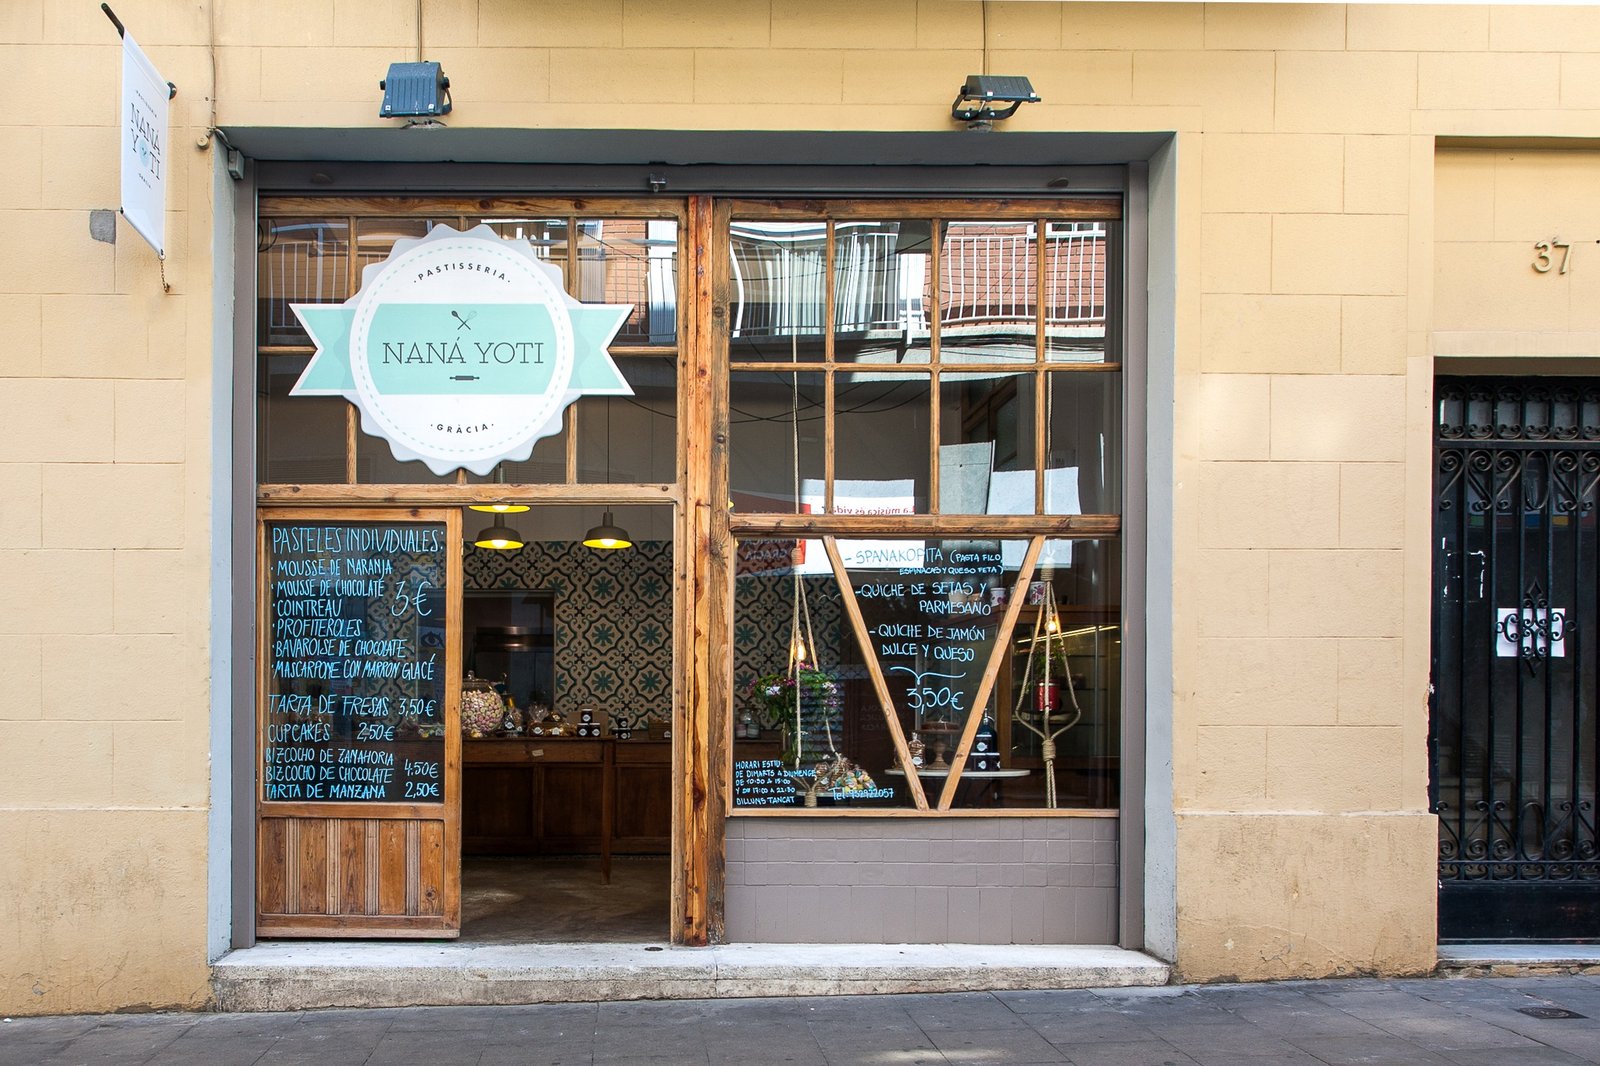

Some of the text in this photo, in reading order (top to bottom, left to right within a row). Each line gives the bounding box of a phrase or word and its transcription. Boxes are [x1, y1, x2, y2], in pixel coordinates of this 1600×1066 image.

[1532, 237, 1571, 275] 37
[382, 337, 544, 364] NANÁ YOTI
[273, 526, 444, 554] PASTELES INDIVIDUALES:
[855, 547, 943, 565] SPANAKOPITA
[277, 558, 393, 580] MOUSSE DE NARANJA
[947, 566, 977, 575] QUESO
[277, 579, 385, 598] MOUSSE DE CHOCOLATE
[911, 583, 926, 596] DE
[932, 582, 974, 596] SETAS
[980, 582, 988, 598] Y
[277, 599, 342, 618] COINTREAU
[919, 600, 991, 616] PARMESANO
[277, 618, 363, 640] PROFITEROLES
[927, 624, 944, 639] DE
[945, 625, 985, 641] JAMÓN
[275, 638, 408, 658] BAVAROISE DE CHOCOLATE
[882, 643, 975, 662] DULCE Y QUESO
[273, 653, 436, 681] MASCARPONE CON MARRON GLACÉ
[268, 694, 437, 717] TARTA DE FRESAS 3,50€
[906, 686, 965, 715] 3,50€
[356, 722, 396, 743] 2,50€
[265, 747, 395, 766] BIZCOCHO DE ZANAHORIA
[735, 760, 760, 769] HORARI
[265, 765, 395, 784] BIZCOCHO DE CHOCOLATE
[735, 770, 744, 779] DE
[746, 769, 775, 778] DIMARTS
[264, 781, 440, 800] TARTA DE MANZANA 2,50€
[735, 786, 740, 795] Y
[736, 795, 795, 806] DILLUNS TANCAT
